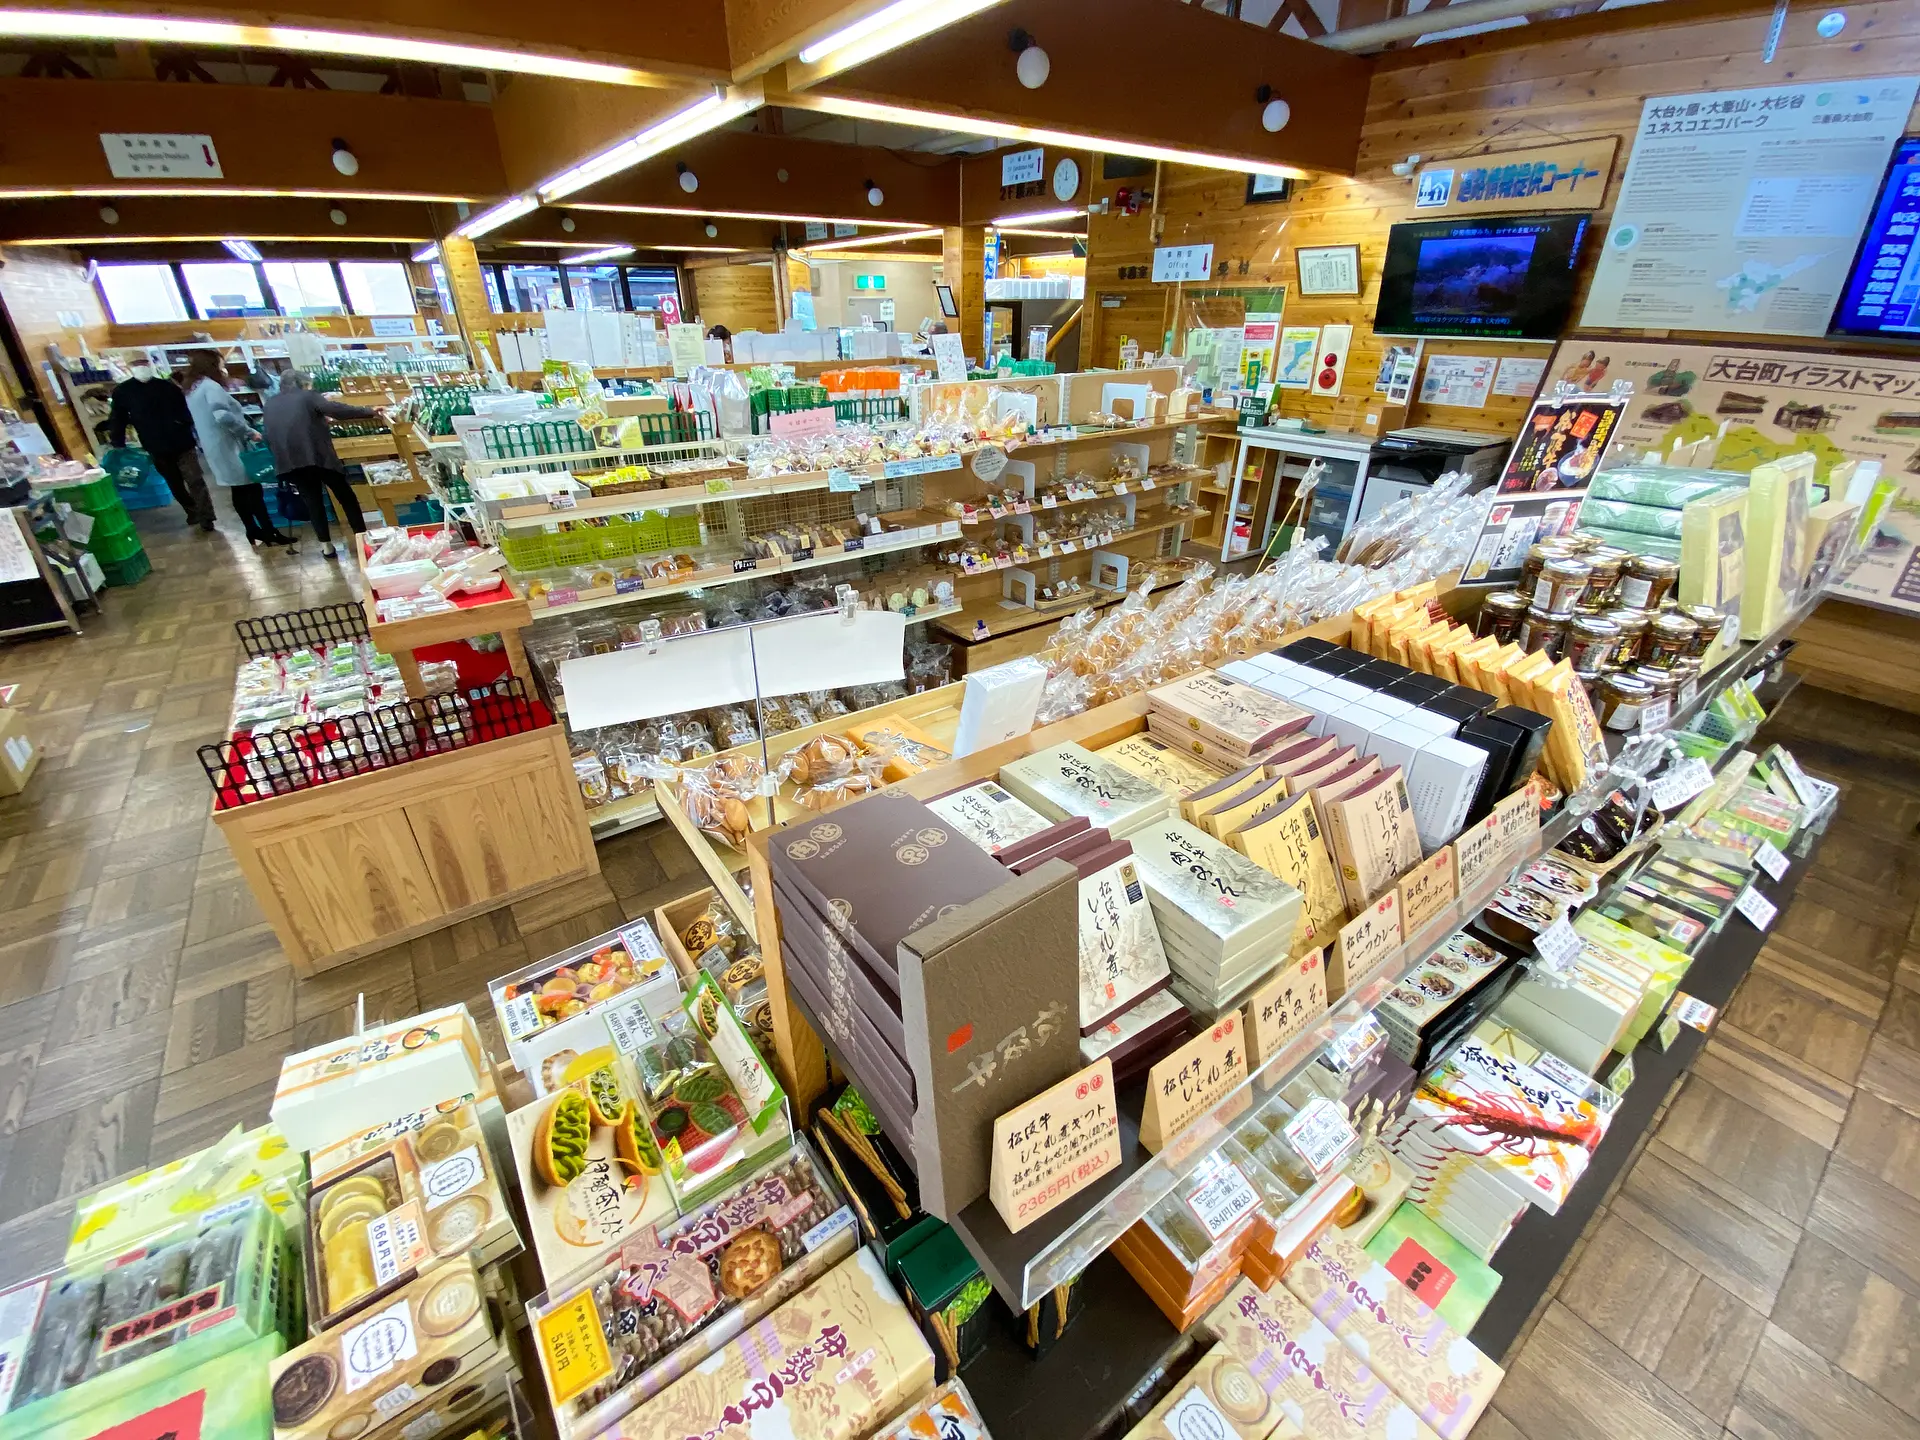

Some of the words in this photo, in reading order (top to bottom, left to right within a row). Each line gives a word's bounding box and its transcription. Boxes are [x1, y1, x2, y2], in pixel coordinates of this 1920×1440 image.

[1645, 115, 1769, 135] ユネスコエコパーク
[1168, 261, 1189, 269] Office
[1709, 359, 1920, 396] 大台町イラストマッ
[1384, 788, 1401, 841] 松阪牛
[1165, 831, 1211, 860] 松阪牛
[1289, 817, 1310, 869] 松阪牛
[1170, 850, 1246, 898] 肉みそ
[1099, 880, 1120, 931] 松阪牛
[1087, 897, 1125, 982] しぐれ煮
[1346, 921, 1372, 951] 松阪牛
[1348, 923, 1397, 969] ビーフカレー
[631, 1001, 654, 1038] 伊勢茶たると
[1262, 988, 1293, 1022] 松阪牛
[1279, 983, 1316, 1029] 肉みそ
[1163, 1058, 1202, 1096] 松阪牛
[1183, 1047, 1239, 1102] しぐれ煮
[1007, 1112, 1051, 1150] 松阪牛
[1020, 1103, 1105, 1164] しぐれ煮ギフト
[1018, 1150, 1110, 1218] 2365円(税込)
[808, 1212, 848, 1244] 商品見本
[1209, 1189, 1253, 1229] 584円(税込)
[371, 1222, 392, 1261] 864円
[1304, 1241, 1429, 1359] 伊勢豆せんべい
[550, 1334, 570, 1372] 540円
[574, 1304, 600, 1372] 伊勢豆せんべい
[1238, 1296, 1366, 1428] 伊勢豆せんべい
